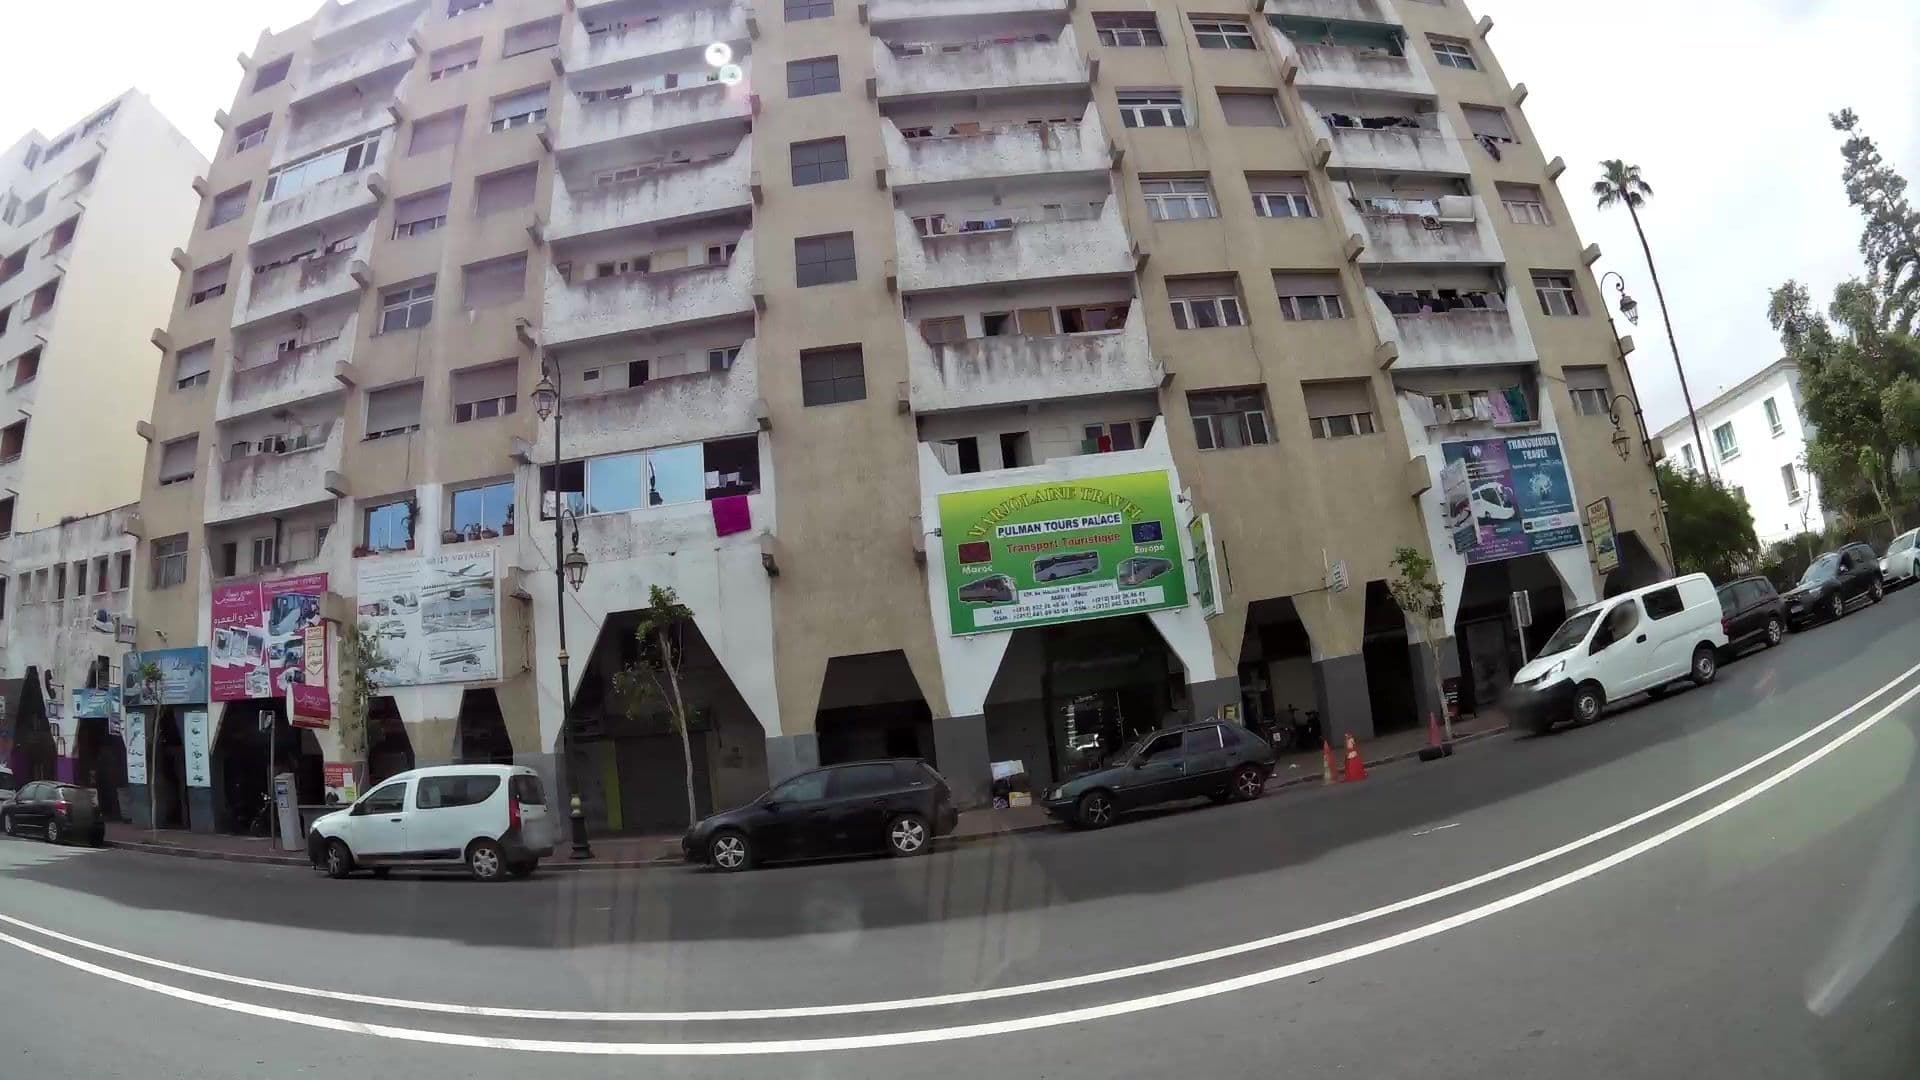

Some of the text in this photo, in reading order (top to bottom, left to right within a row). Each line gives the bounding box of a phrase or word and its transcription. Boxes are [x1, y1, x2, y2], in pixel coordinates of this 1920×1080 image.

[1079, 487, 1145, 521] TRAVEL
[998, 513, 1121, 537] PULMAN TOURS PALACE
[1006, 532, 1121, 554] Transport Touristique
[1134, 543, 1165, 554] Europe
[961, 564, 993, 575] Maroc
